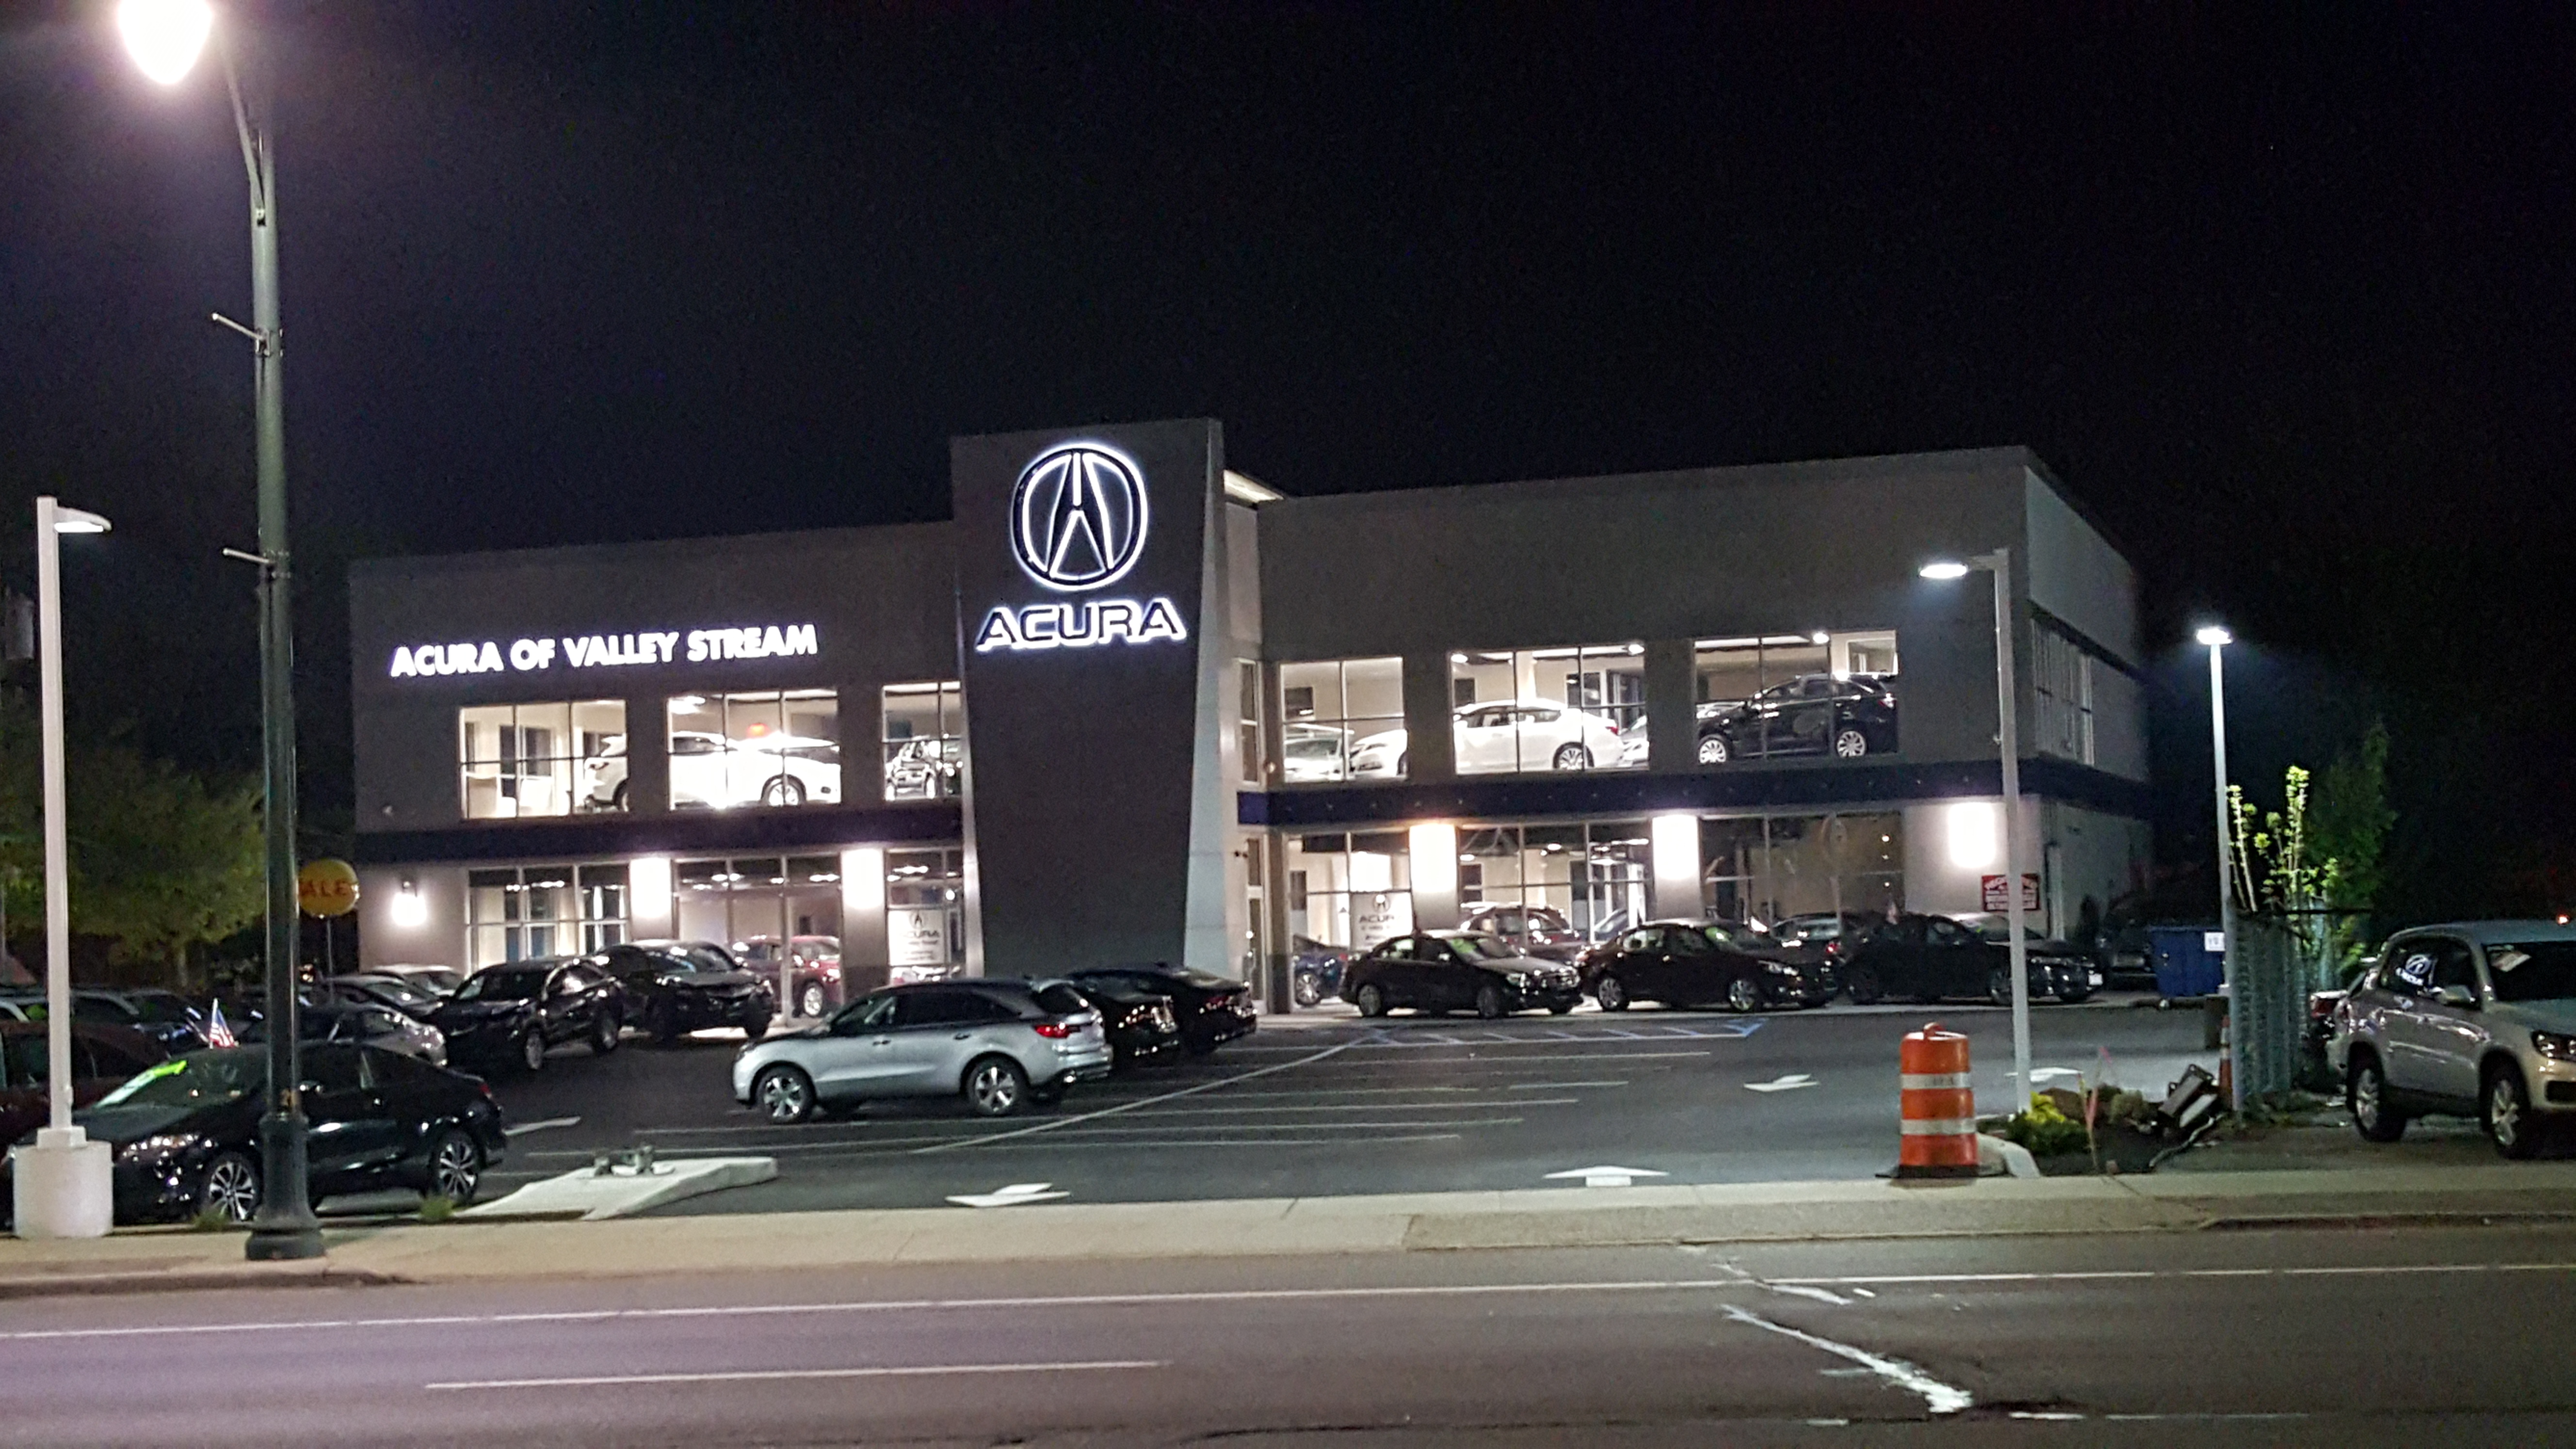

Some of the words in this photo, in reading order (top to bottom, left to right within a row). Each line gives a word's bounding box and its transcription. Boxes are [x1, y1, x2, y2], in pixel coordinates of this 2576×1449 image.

[391, 642, 503, 676] ACURA
[510, 639, 555, 670] OF
[563, 631, 679, 667] VALLEY
[687, 624, 817, 661] STREAM
[976, 597, 1187, 651] ACURA
[299, 879, 348, 897] ALE
